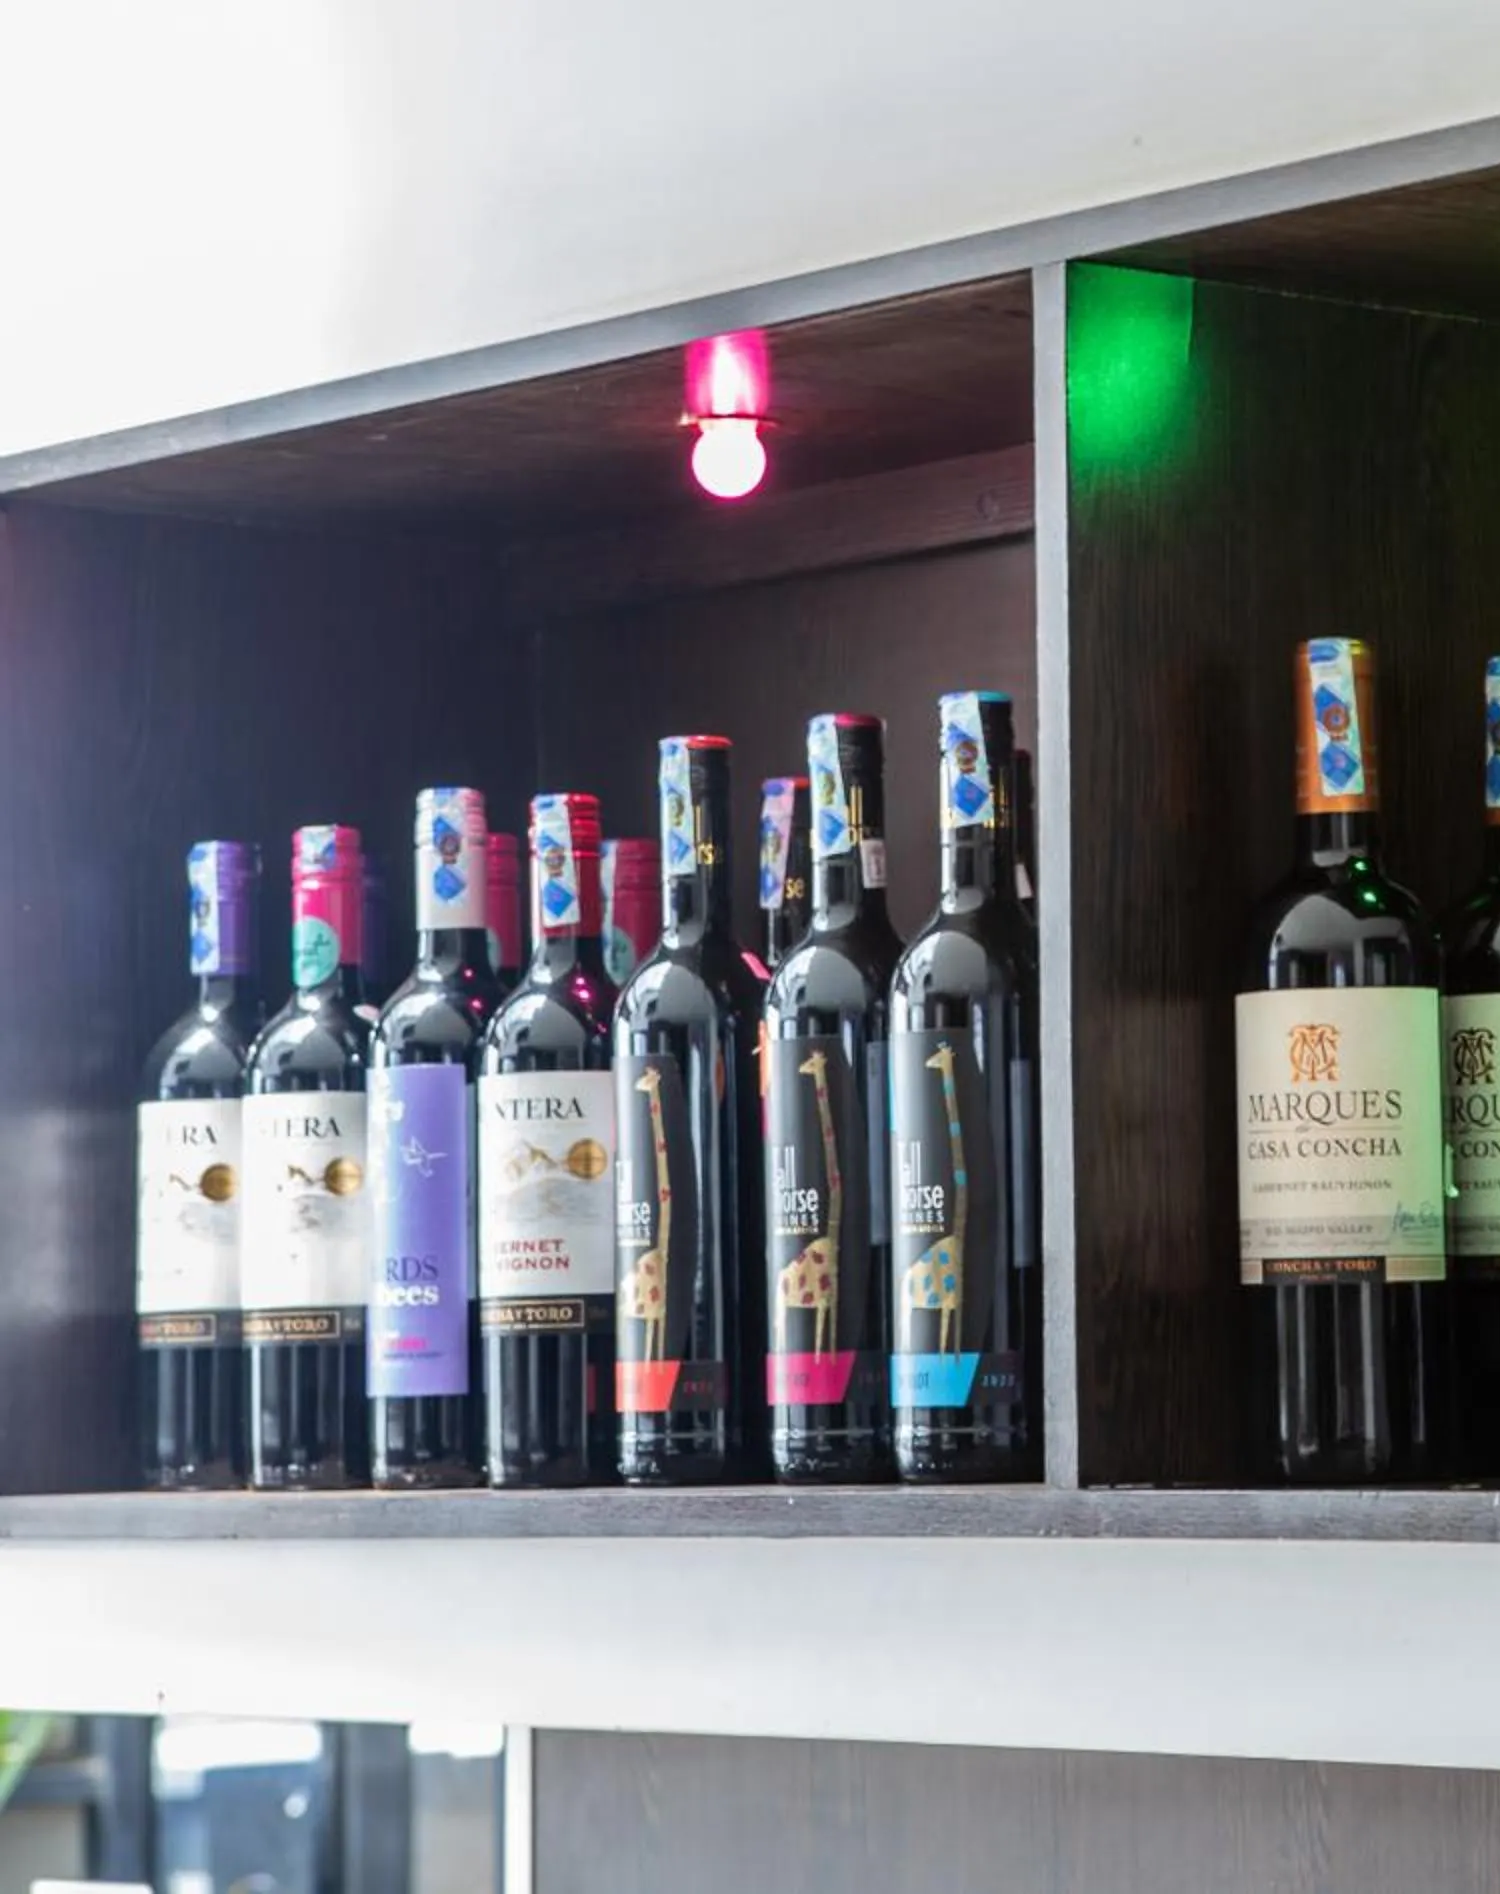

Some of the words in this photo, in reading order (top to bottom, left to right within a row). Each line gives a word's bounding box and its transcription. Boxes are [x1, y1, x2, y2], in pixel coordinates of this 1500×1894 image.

[1248, 1088, 1403, 1126] MARQUES
[1248, 1140, 1290, 1160] CASA
[1297, 1136, 1403, 1158] CONCHA
